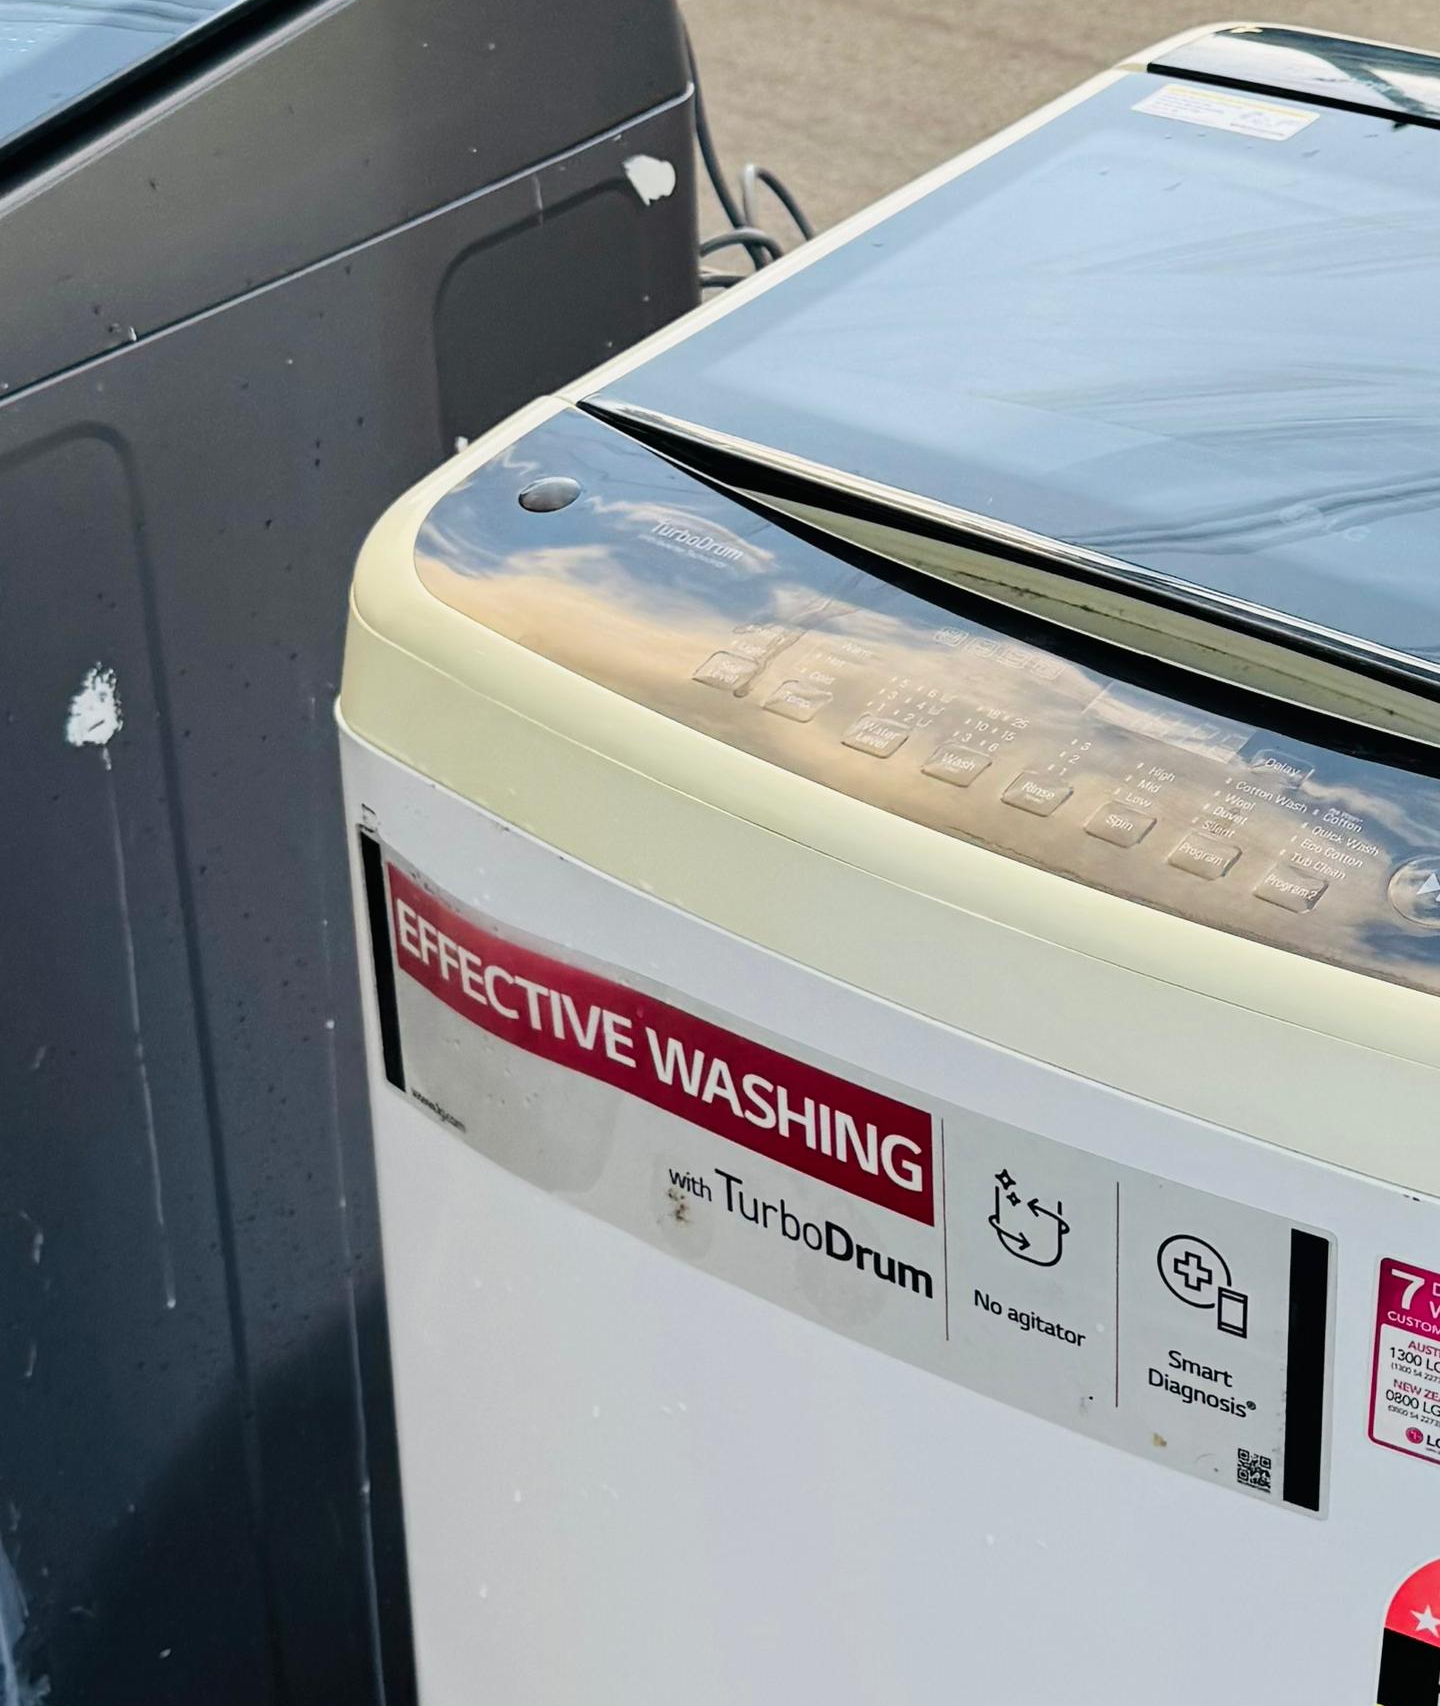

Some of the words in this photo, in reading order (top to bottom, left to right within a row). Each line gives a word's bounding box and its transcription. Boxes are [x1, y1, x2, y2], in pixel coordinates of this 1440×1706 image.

[652, 518, 743, 561] TurboDrum
[861, 720, 901, 741] Water
[974, 720, 988, 731] 10
[1000, 730, 1016, 742] 15
[1012, 717, 1030, 729] 25
[855, 731, 889, 750] Level
[941, 752, 977, 772] Wash
[1068, 754, 1080, 764] 2
[1263, 757, 1301, 779] Delay
[1148, 766, 1176, 783] High
[1021, 781, 1055, 799] Rinse
[1137, 779, 1162, 794] Mid
[1125, 792, 1151, 808] Low
[1224, 793, 1256, 812] Wool
[1235, 781, 1273, 802] Cotton
[1275, 795, 1308, 815] Wash
[1105, 814, 1134, 832] Spin
[1212, 805, 1248, 825] Duvet
[1323, 812, 1362, 833] Cotton
[1201, 819, 1236, 839] Silent
[1312, 826, 1342, 844] Quick
[1347, 838, 1380, 857] Wash
[1300, 839, 1323, 854] Eco
[1324, 847, 1364, 868] Cotton
[1291, 852, 1312, 867] Tub
[1313, 861, 1347, 880] Clean
[397, 898, 637, 1069] EFFECTIVE
[645, 1025, 923, 1192] WASHING
[669, 1168, 712, 1202] with
[714, 1168, 933, 1299] TurboDrum
[1391, 1268, 1425, 1311] 7
[974, 1289, 1002, 1316] No
[1007, 1306, 1086, 1347] agitator
[1389, 1347, 1423, 1367] 1300
[1168, 1350, 1233, 1388] Smart
[1393, 1379, 1422, 1396] NEW
[1386, 1389, 1420, 1410] 0800
